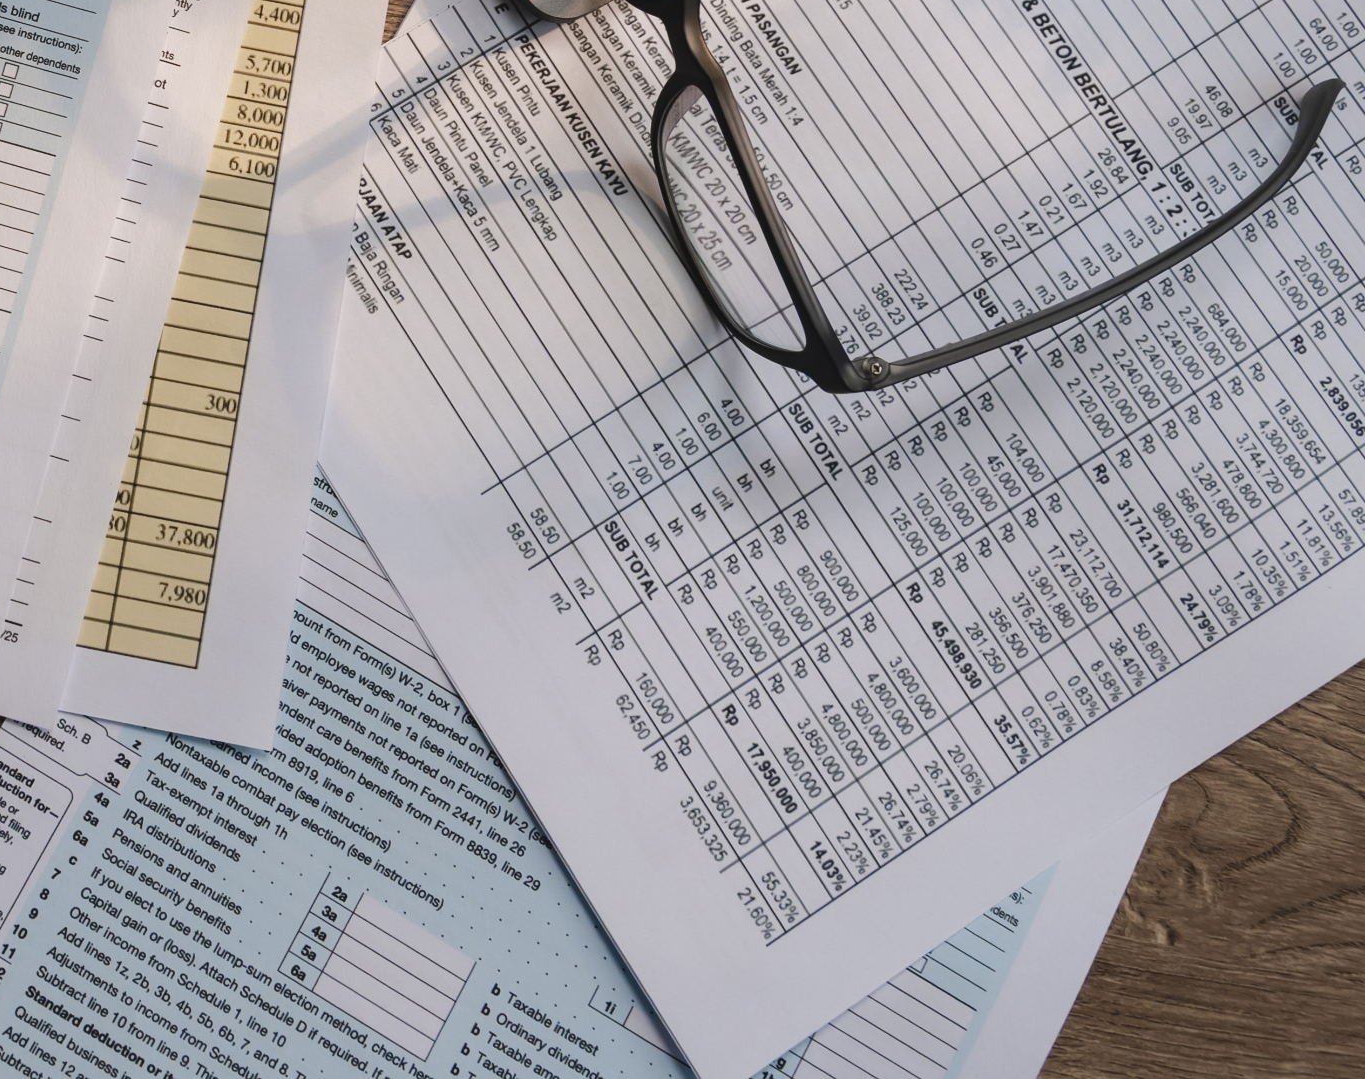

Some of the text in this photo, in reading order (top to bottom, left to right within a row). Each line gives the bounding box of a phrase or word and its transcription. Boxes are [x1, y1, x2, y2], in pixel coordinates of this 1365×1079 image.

[253, 3, 301, 27] 4,400
[245, 54, 292, 76] 5,700
[491, 46, 541, 117] Kusen Pintu
[224, 128, 280, 152] 12,000
[515, 33, 629, 196] PEKERJAAN KUSEN KAYU
[227, 156, 276, 181] 6,100
[377, 114, 419, 174] Kaca Mati
[893, 268, 929, 311] 222.24
[204, 393, 237, 414] 300
[156, 523, 216, 552] 37,800
[604, 520, 659, 601] SUB TOTAL
[1116, 499, 1170, 569] 31,712,114
[159, 581, 207, 606] 7,980
[1179, 592, 1218, 643] 24.79%
[931, 621, 983, 690] 45,498,930
[964, 621, 1006, 674] 281,250
[1132, 622, 1171, 673] 50.80%
[635, 672, 675, 725] 160,000
[993, 714, 1031, 765] 35.57%
[747, 742, 798, 814] 17,950,000
[134, 789, 241, 863] Qualified dividends
[146, 769, 258, 847] Tax-exempt interest
[703, 780, 752, 846] 9,360,000
[122, 808, 217, 874] IRA distributions
[810, 840, 846, 892] 14.03%
[507, 991, 599, 1057] Taxable interest
